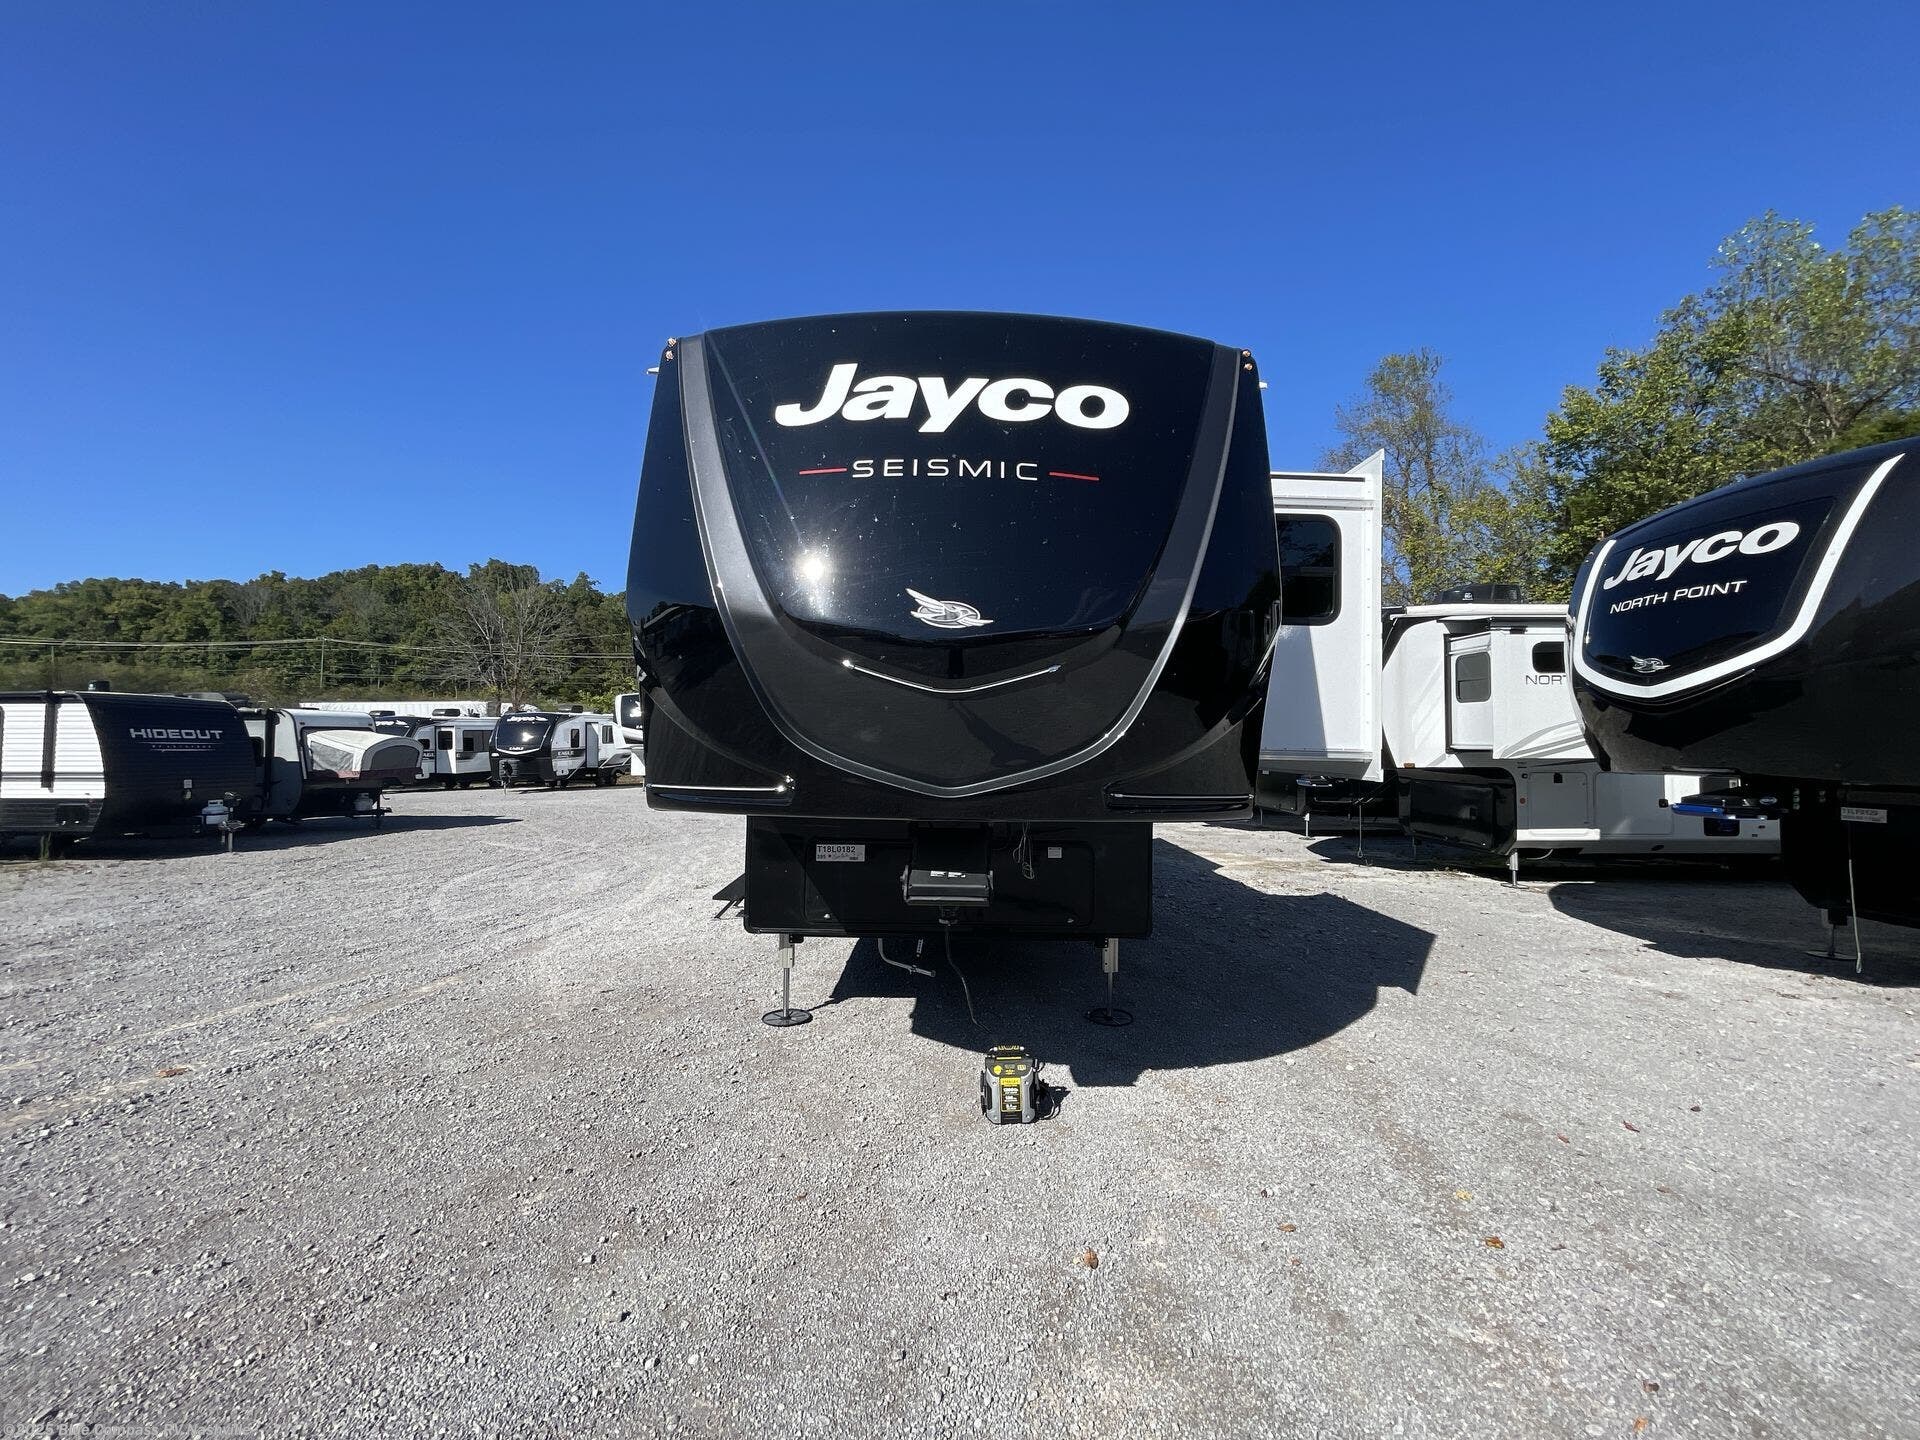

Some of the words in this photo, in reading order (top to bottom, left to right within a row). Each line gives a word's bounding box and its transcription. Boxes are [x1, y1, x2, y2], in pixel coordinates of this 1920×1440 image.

[774, 362, 1130, 433] Jayco
[852, 458, 1039, 482] SEISMIC
[1603, 521, 1800, 590] Jayco
[1609, 591, 1668, 615] NORTH
[1673, 580, 1748, 601] POINT
[129, 728, 223, 739] HIDEOUT
